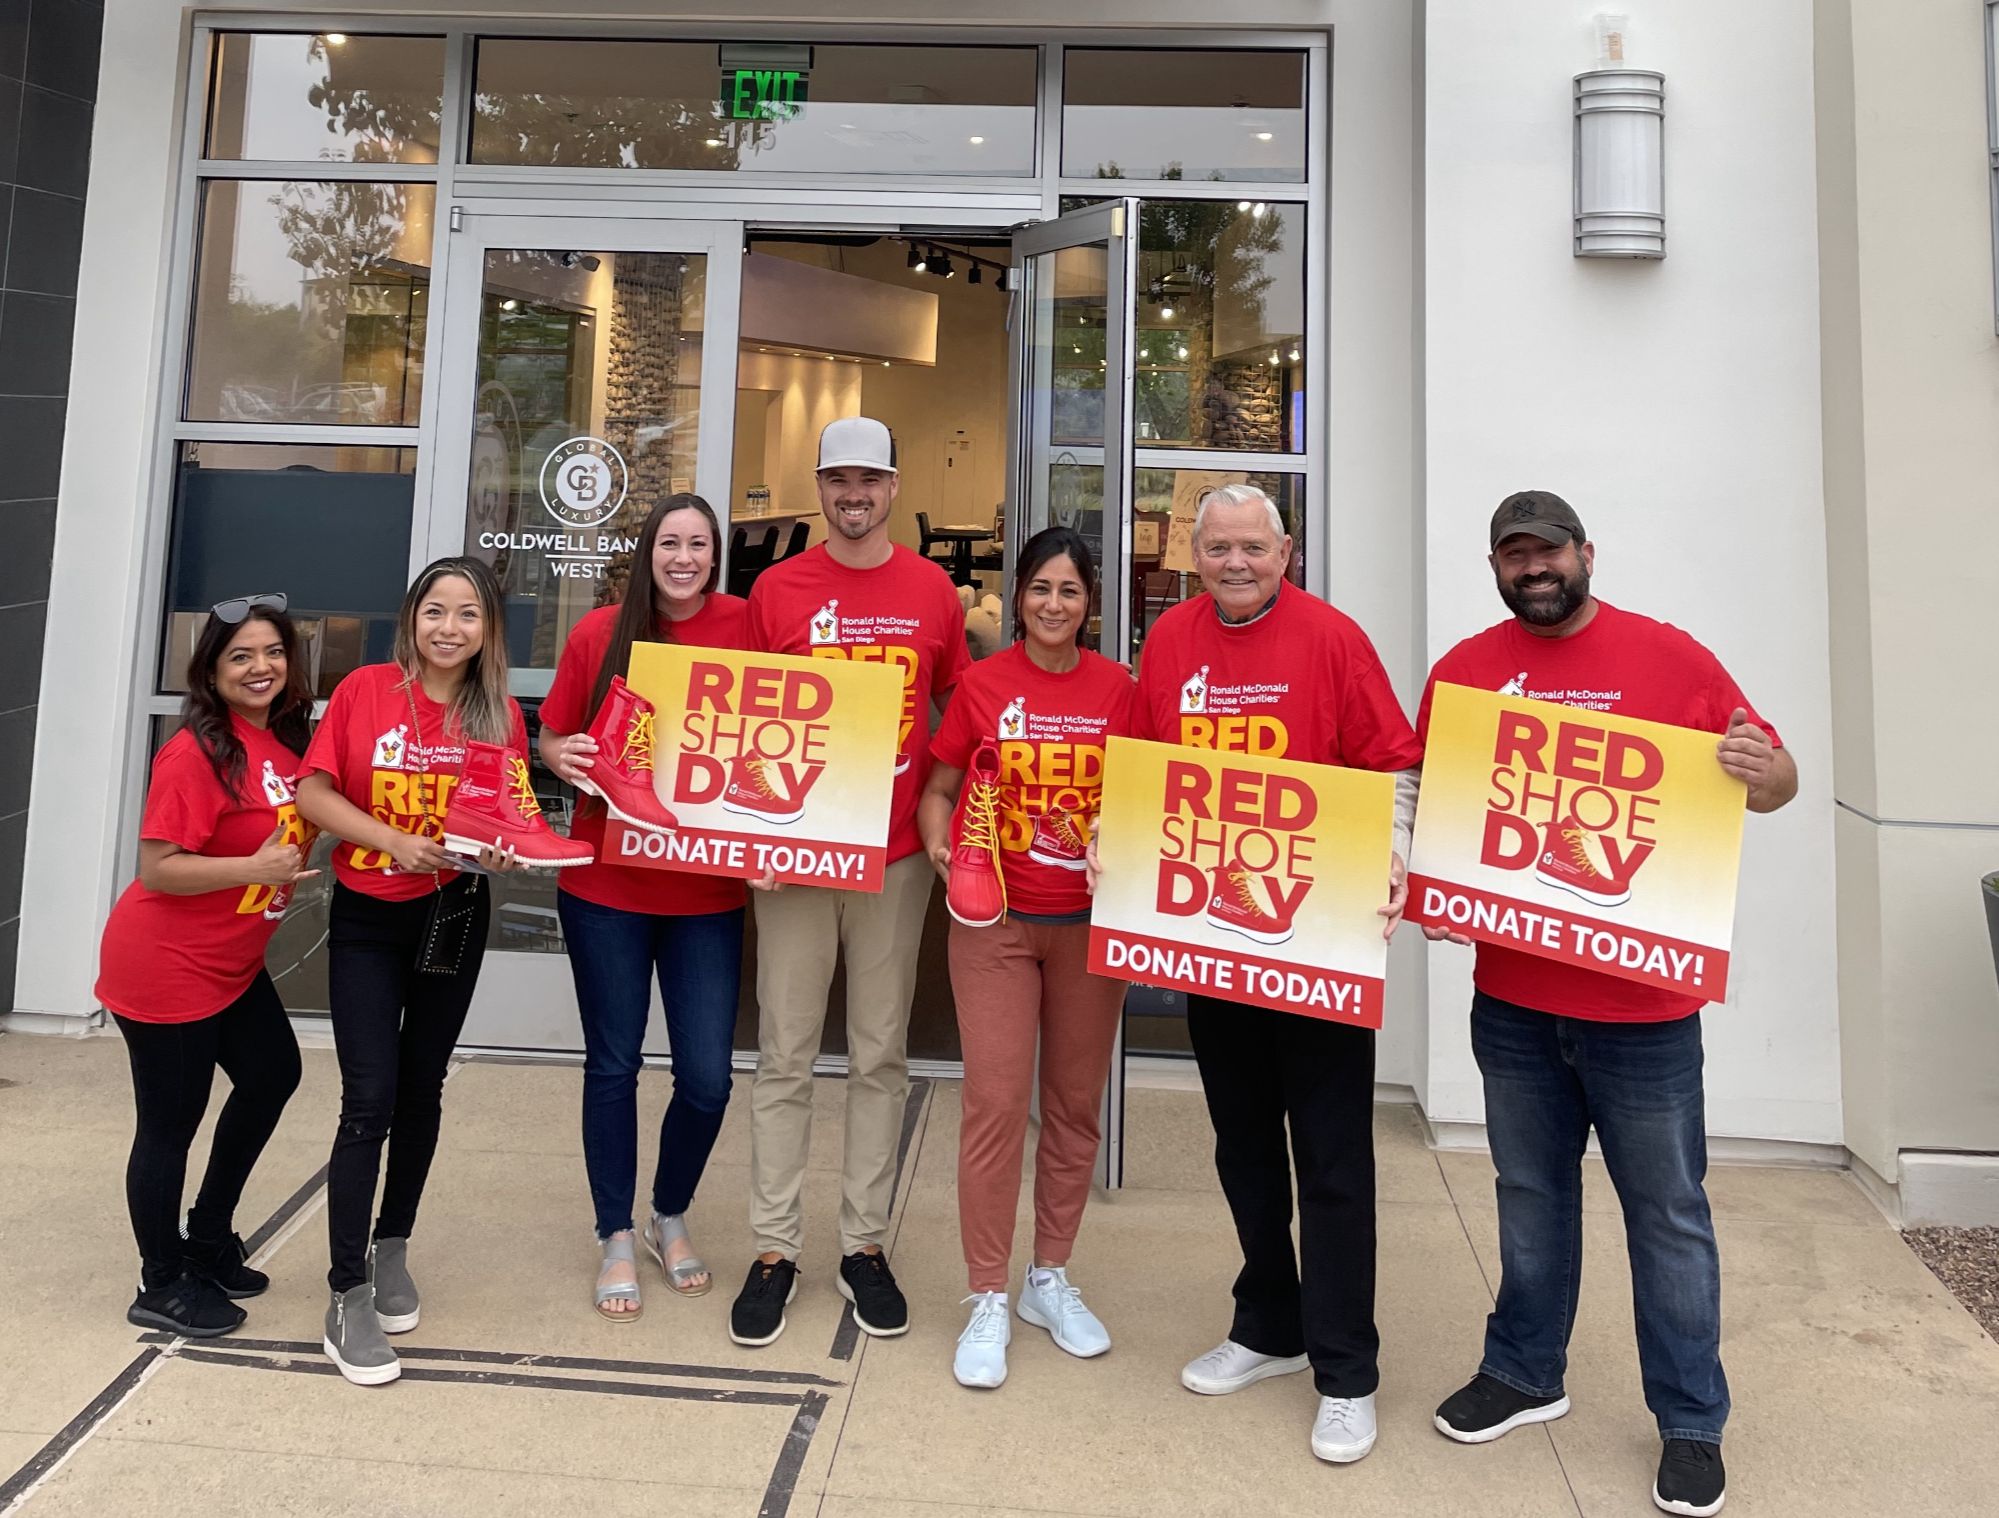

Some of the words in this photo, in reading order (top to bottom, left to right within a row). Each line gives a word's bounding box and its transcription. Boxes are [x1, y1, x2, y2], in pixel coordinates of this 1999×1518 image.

[733, 70, 800, 118] EXIT
[724, 121, 776, 150] 115
[555, 443, 616, 465] GLOBAL
[551, 498, 612, 521] LUXURY
[479, 532, 591, 552] COLDWELL
[597, 535, 639, 553] BAN
[551, 562, 606, 579] WEST
[841, 617, 875, 626] Ronald
[876, 617, 920, 628] McDonald
[841, 627, 871, 635] House
[685, 661, 834, 722] RED
[1209, 696, 1237, 705] House
[1210, 685, 1240, 695] Ronald
[1242, 683, 1289, 694] McDonald
[1528, 690, 1565, 700] Ronald
[1566, 689, 1622, 700] McDonald
[1029, 713, 1063, 724] Ronald
[1064, 715, 1108, 726] McDonald
[1029, 723, 1060, 732] House
[679, 712, 831, 766] SHOE
[1493, 709, 1664, 792] RED
[1000, 741, 1104, 787] RED
[1163, 760, 1318, 832] RED
[1487, 766, 1661, 845] SHOE
[620, 829, 747, 869] DONATE
[753, 843, 866, 881] TODAY!
[1159, 816, 1316, 882] SHOE
[1423, 887, 1565, 950] DONATE
[1569, 924, 1705, 986] TODAY!
[1106, 938, 1234, 990] DONATE
[1240, 968, 1362, 1015] TODAY!
